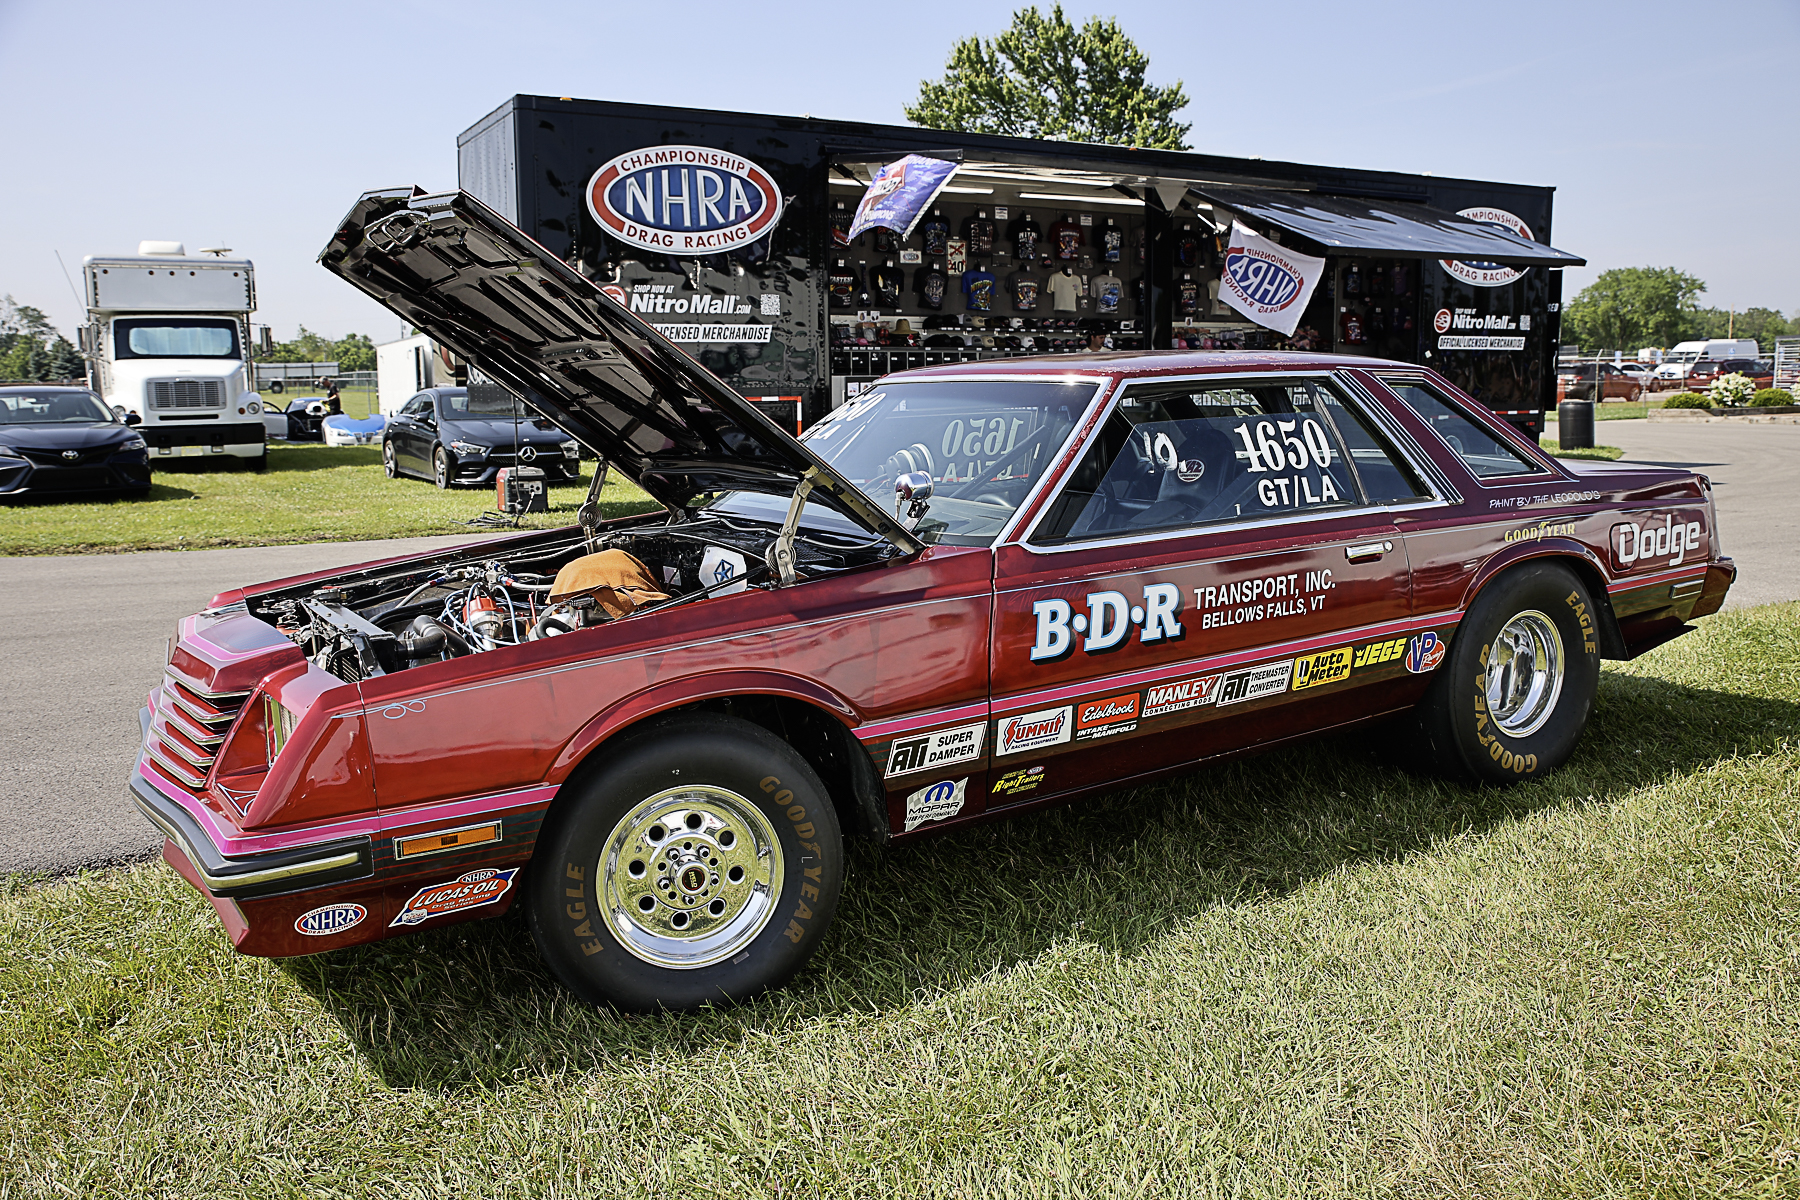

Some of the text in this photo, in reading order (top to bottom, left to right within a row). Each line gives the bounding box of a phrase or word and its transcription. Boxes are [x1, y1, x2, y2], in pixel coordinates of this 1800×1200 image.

[621, 150, 745, 172] CHAMPIONSHIP
[626, 168, 752, 227] NHRA
[1463, 211, 1519, 228] AMPIONSHIP
[626, 225, 747, 248] DRAG RACING
[1453, 263, 1477, 281] DRAG
[633, 284, 675, 294] SHOP NOW AT
[656, 326, 770, 340] ICENSED MERCHANDISE
[1439, 336, 1524, 349] OFFICIAL LICENSED MERCHANDISE
[1234, 419, 1331, 473] 1650
[1257, 475, 1339, 507] GT/LA
[1489, 490, 1601, 509] PAINT BY THE LEOPOLD'S
[1619, 513, 1700, 567] Dodge
[1193, 568, 1336, 610] TRANSPORT, INC.
[1202, 595, 1326, 630] BELLOWS FALLS, VT
[1565, 589, 1596, 654] EAGLE
[1311, 652, 1344, 670] Auto
[1353, 637, 1408, 667] JEGS
[1411, 632, 1438, 672] VP
[1251, 665, 1290, 682] TREEMASTER
[1309, 663, 1349, 682] Meter
[1146, 678, 1215, 707] MANLEY
[1220, 671, 1252, 702] ATI
[1249, 678, 1285, 694] CONVERTER
[1081, 699, 1135, 723] Edelbrock
[1144, 696, 1212, 716] CONNECTING RODS
[937, 731, 974, 747] SUPER
[1077, 724, 1109, 737] INTAKE
[1091, 724, 1137, 739] MANIFOLD
[1030, 736, 1059, 747] EQUIPMENT
[890, 736, 930, 773] ATI
[928, 744, 975, 763] DAMPER
[908, 801, 960, 815] MOPAR
[465, 871, 491, 883] NHRA
[413, 879, 500, 909] LUCAS OIL
[432, 892, 491, 909] Drag Racing
[307, 904, 354, 917] CHAMPIONSHIP
[443, 900, 475, 911] Series
[566, 862, 604, 957] EAGLE
[307, 909, 356, 929] NHRA
[329, 920, 358, 934] RACING
